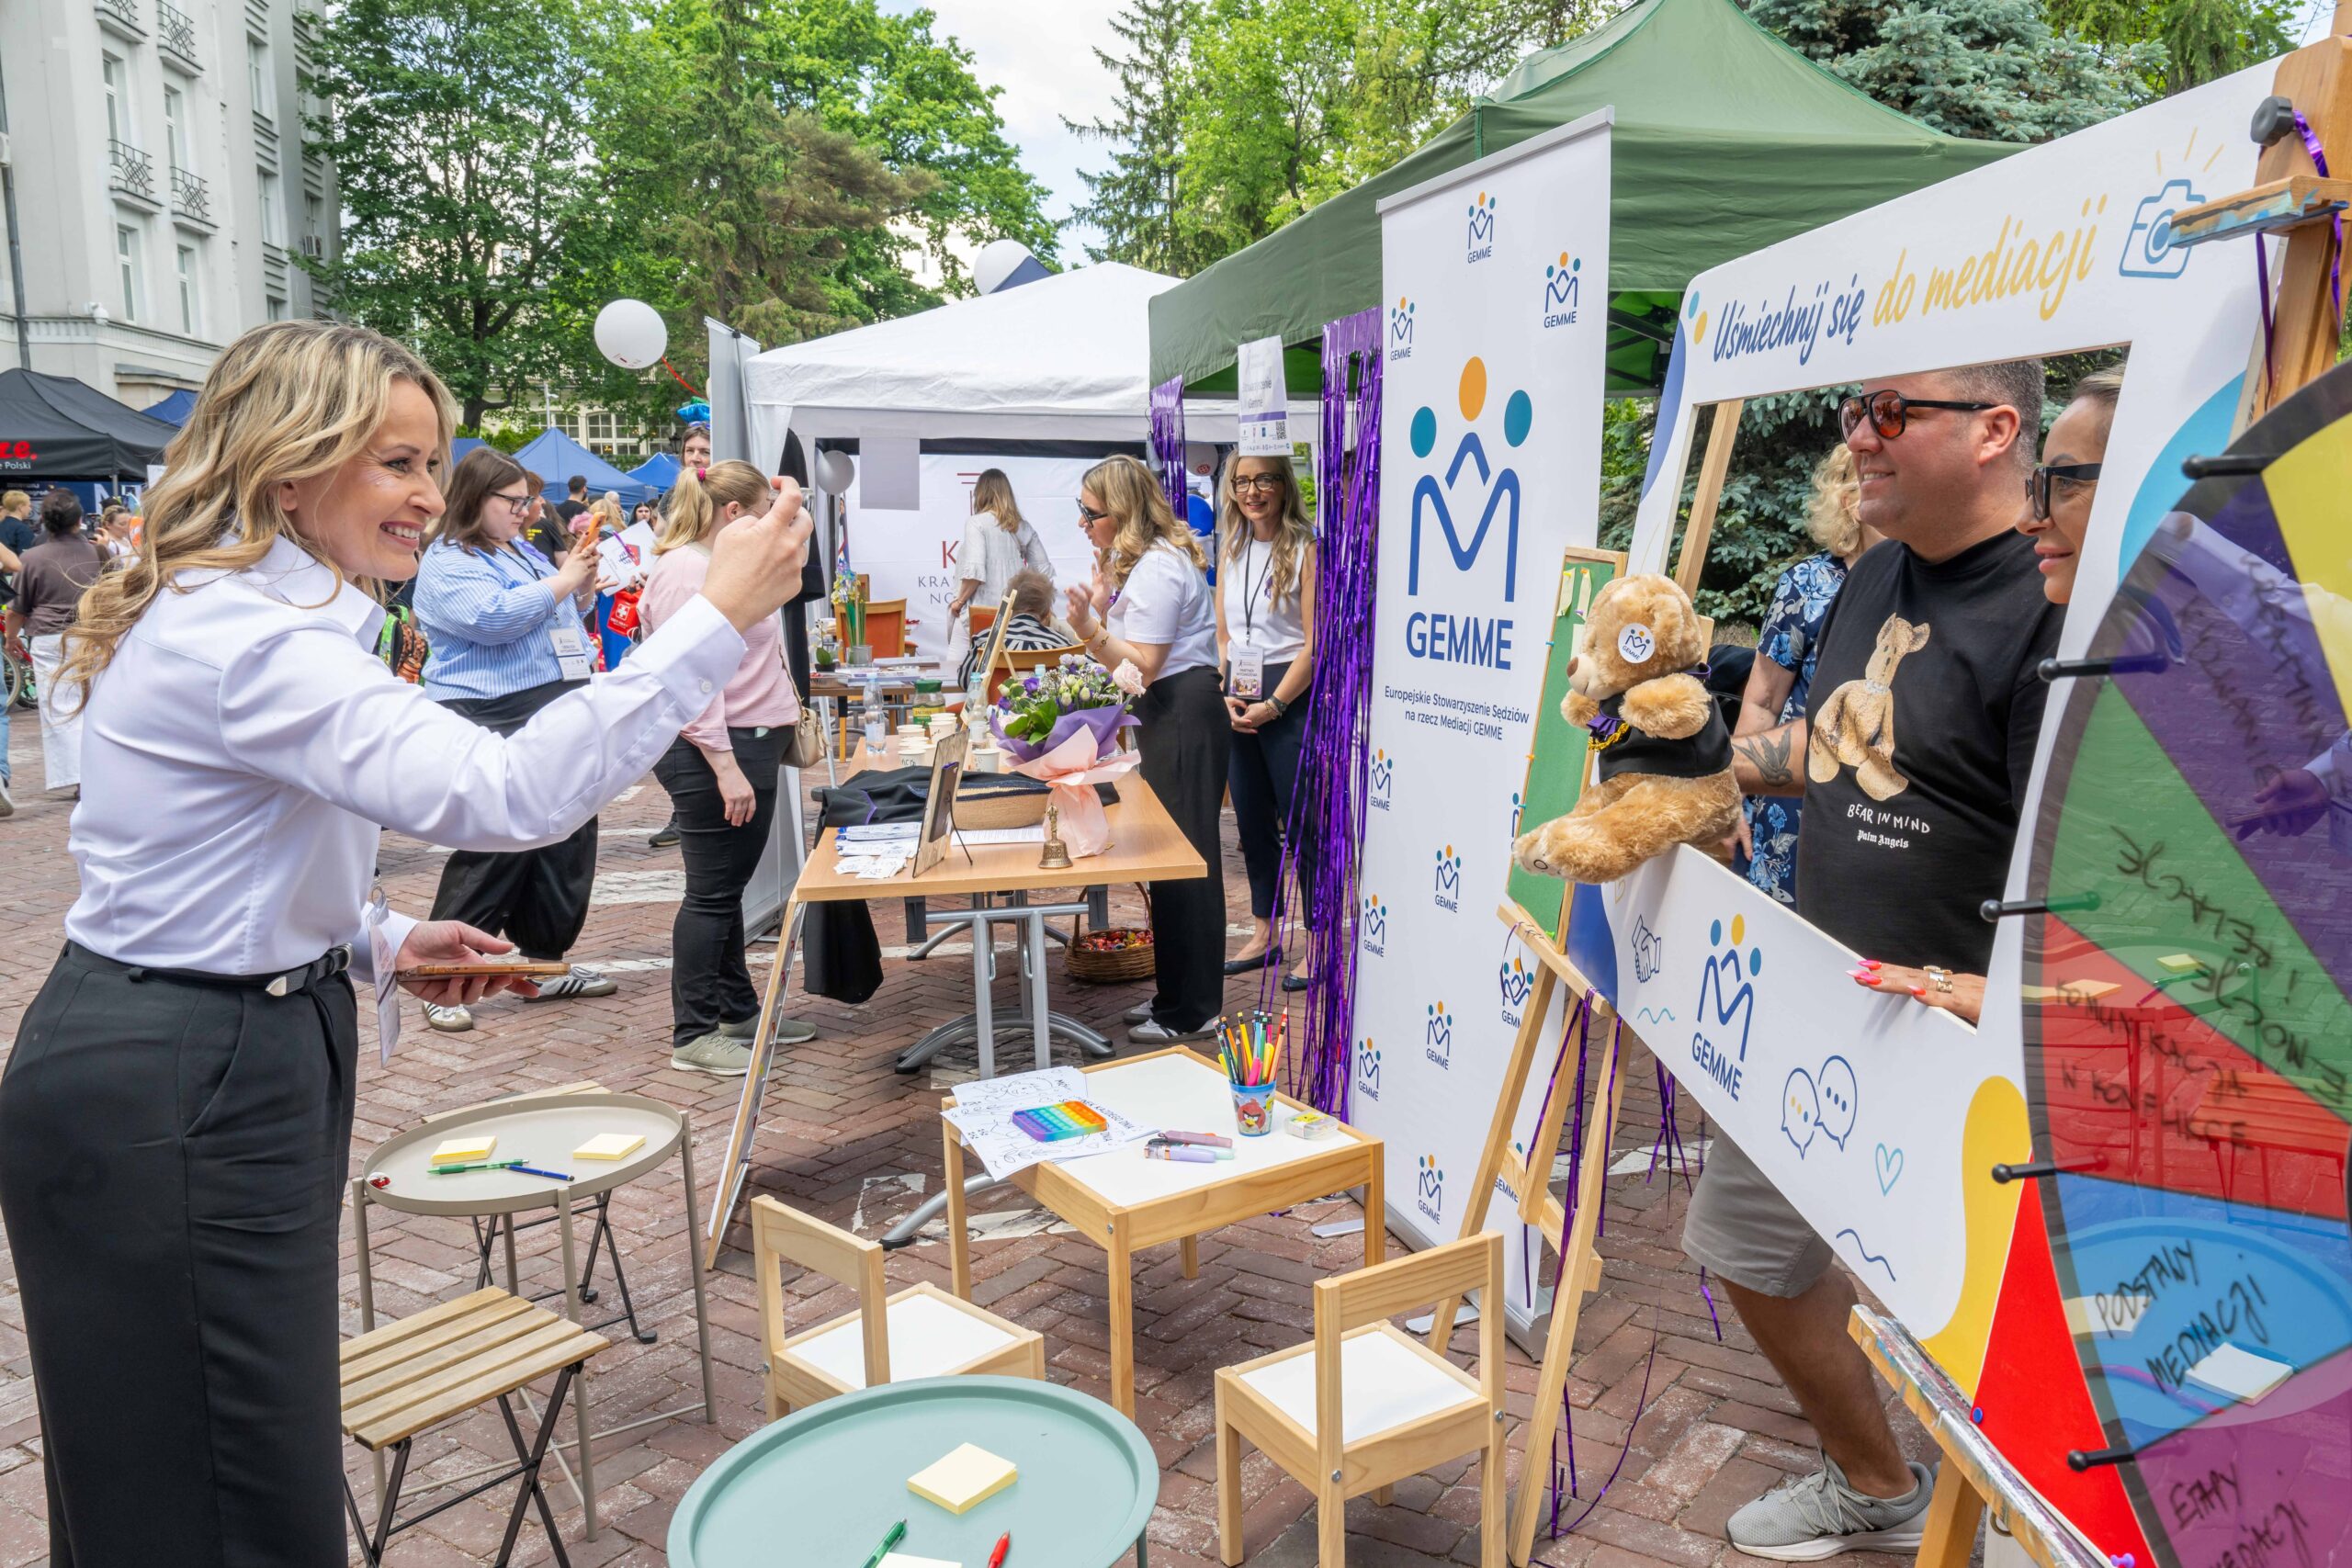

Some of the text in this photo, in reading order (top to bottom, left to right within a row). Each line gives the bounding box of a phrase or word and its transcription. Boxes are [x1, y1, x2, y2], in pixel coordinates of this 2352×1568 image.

[1467, 246, 1492, 264] GEMME
[1713, 194, 2108, 366] Uśmiechnij się do mediacji
[1544, 311, 1577, 328] GEMME
[1390, 347, 1412, 361] GEMME
[1406, 611, 1513, 671] GEMME
[1622, 645, 1641, 661] GEMME
[1385, 685, 1530, 724] Europejskie Stowarzyszenie Sędziów
[1405, 710, 1503, 740] na rzecz Mediacji GEMME
[1370, 795, 1390, 811] GEMME
[1847, 804, 1930, 834] BEAR IN MIND
[1857, 829, 1909, 849] Palm Angels
[1435, 895, 1458, 913] GEMME
[1363, 939, 1385, 957] GEMME
[1426, 1048, 1449, 1070] GEMME
[1691, 1031, 1744, 1103] GEMME
[1358, 1080, 1379, 1101] GEMME
[1418, 1199, 1441, 1225] GEMME
